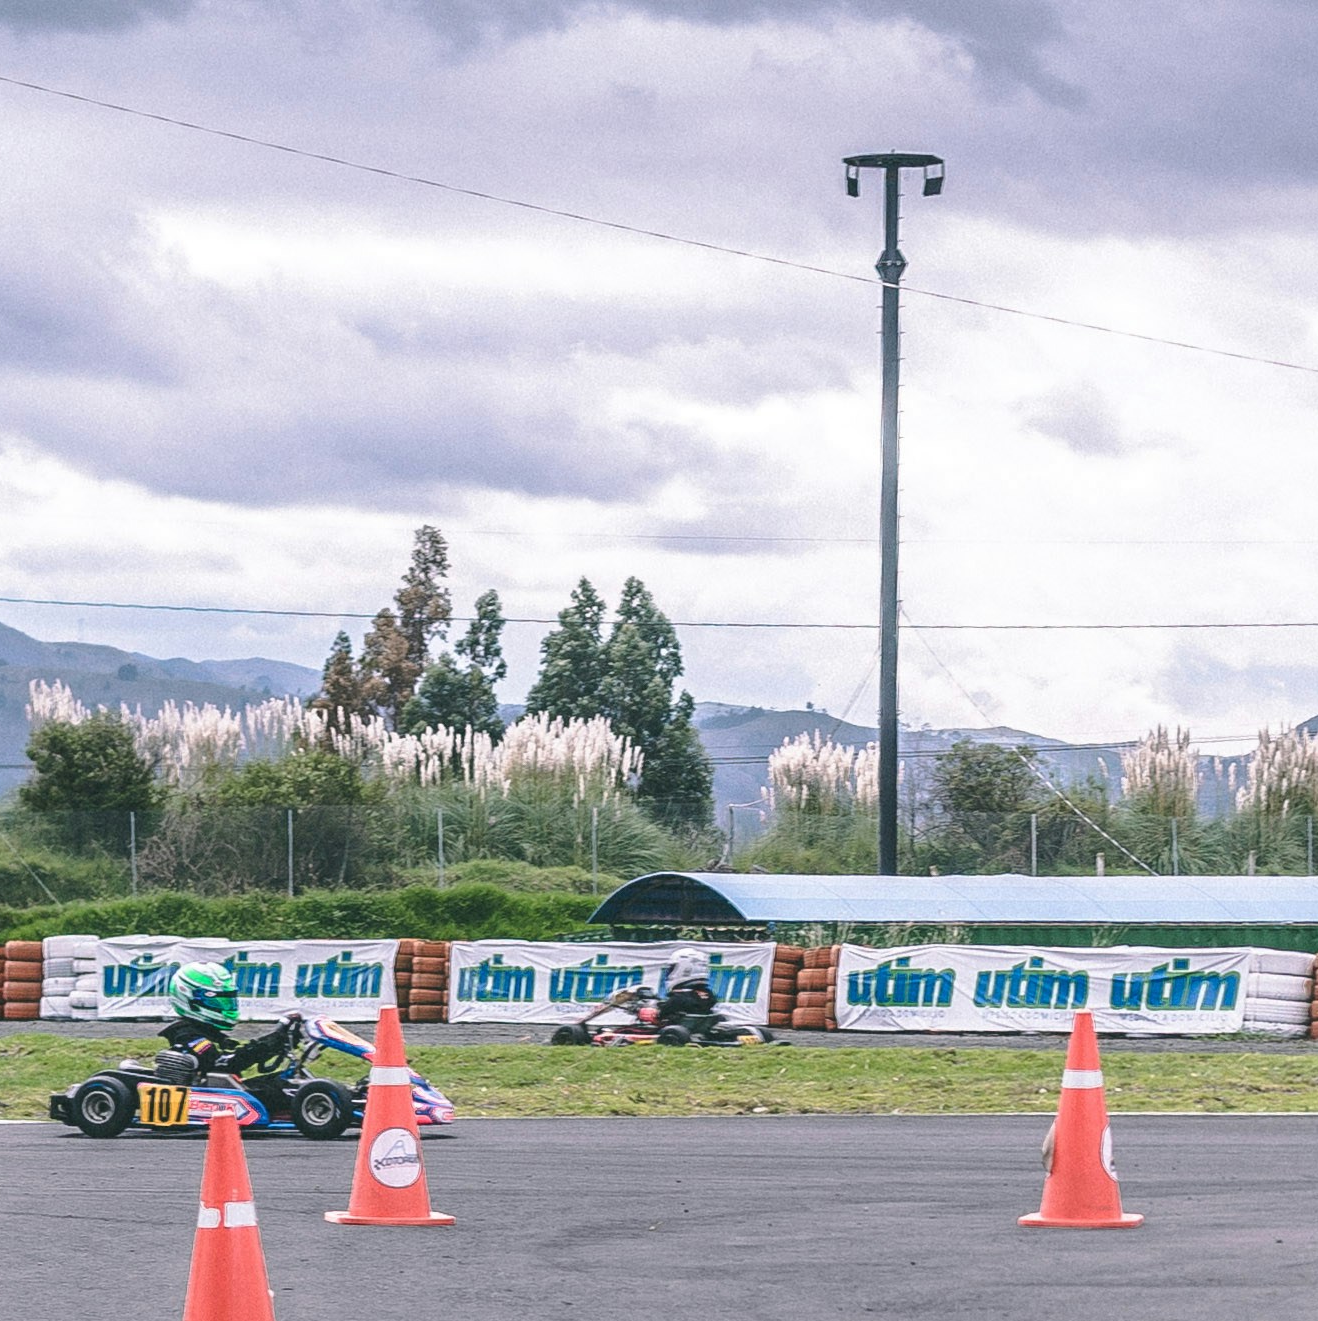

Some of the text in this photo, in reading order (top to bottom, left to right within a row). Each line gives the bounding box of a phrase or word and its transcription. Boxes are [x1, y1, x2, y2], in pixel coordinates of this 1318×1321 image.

[294, 950, 384, 998] utim
[457, 953, 535, 1002] utim
[847, 956, 956, 1008] utim
[973, 956, 1090, 1009] utim
[1109, 957, 1241, 1011] utim
[146, 1086, 188, 1123] 107
